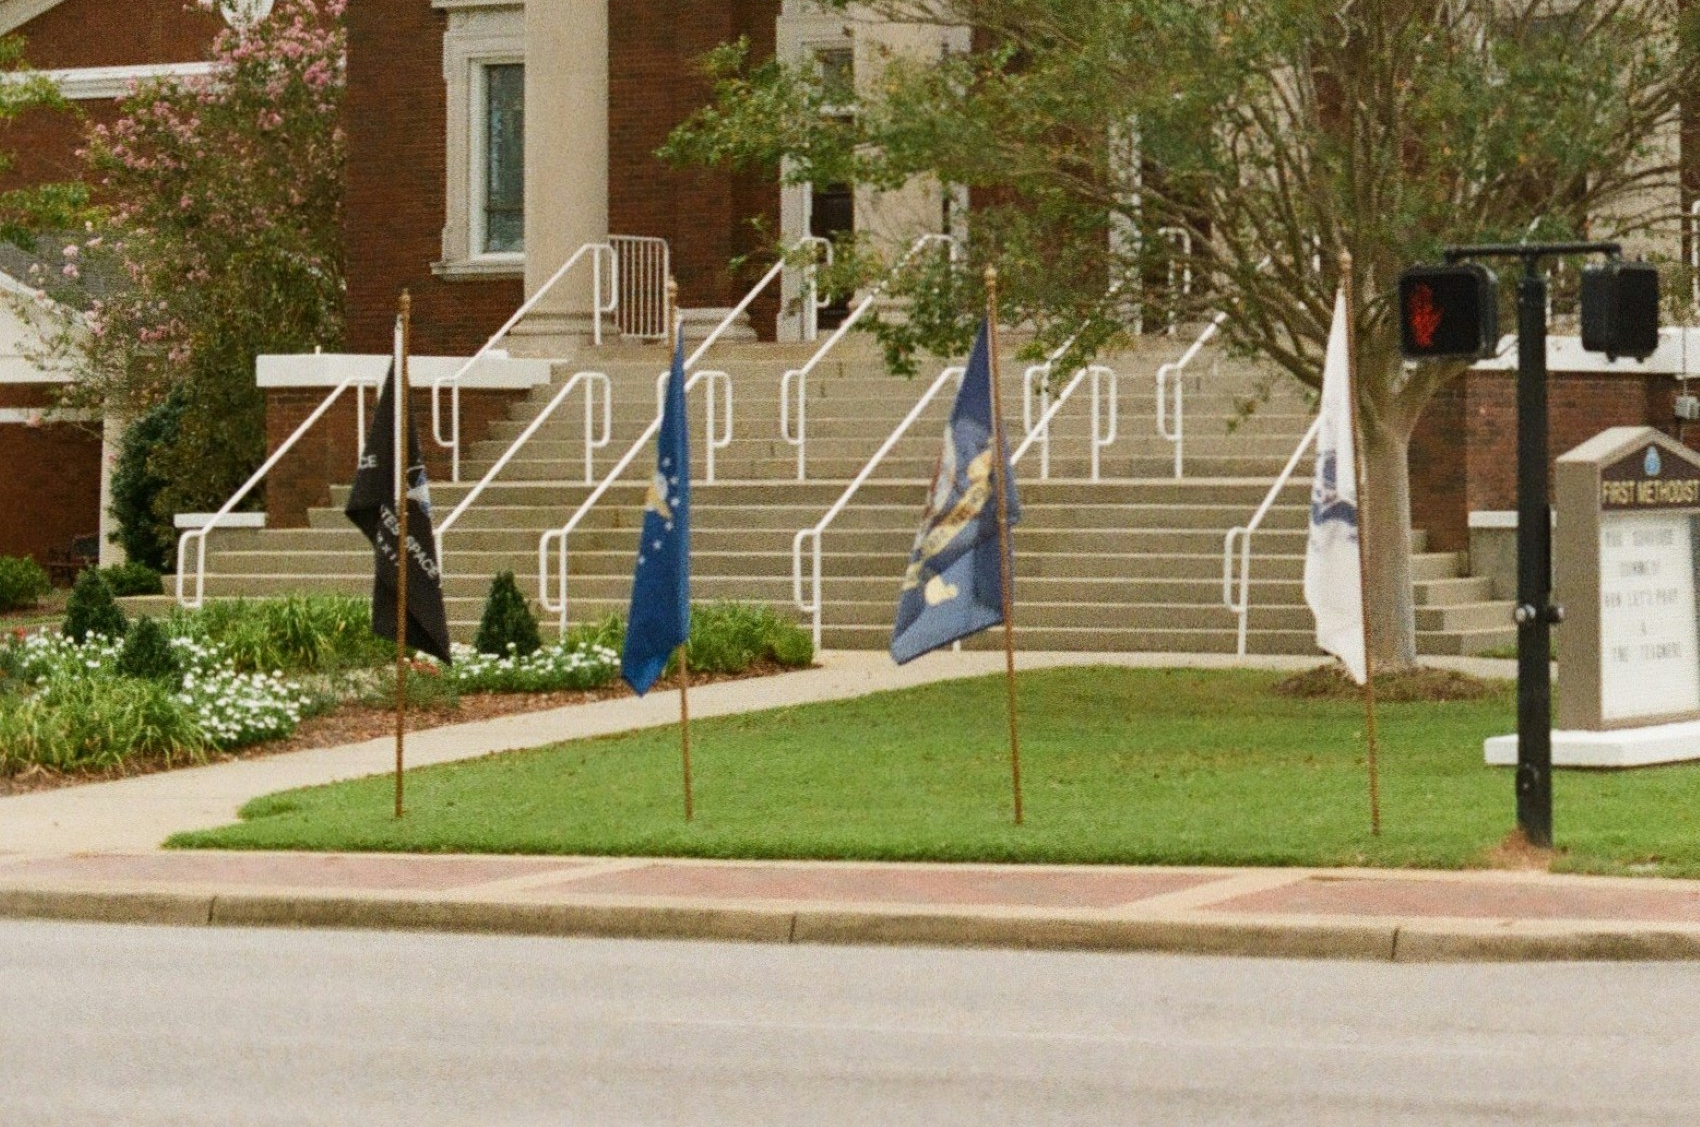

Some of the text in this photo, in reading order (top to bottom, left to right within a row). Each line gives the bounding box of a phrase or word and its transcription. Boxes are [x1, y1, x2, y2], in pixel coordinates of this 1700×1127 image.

[1602, 479, 1700, 504] FIRST METHODIST
[406, 535, 439, 579] SPACE
